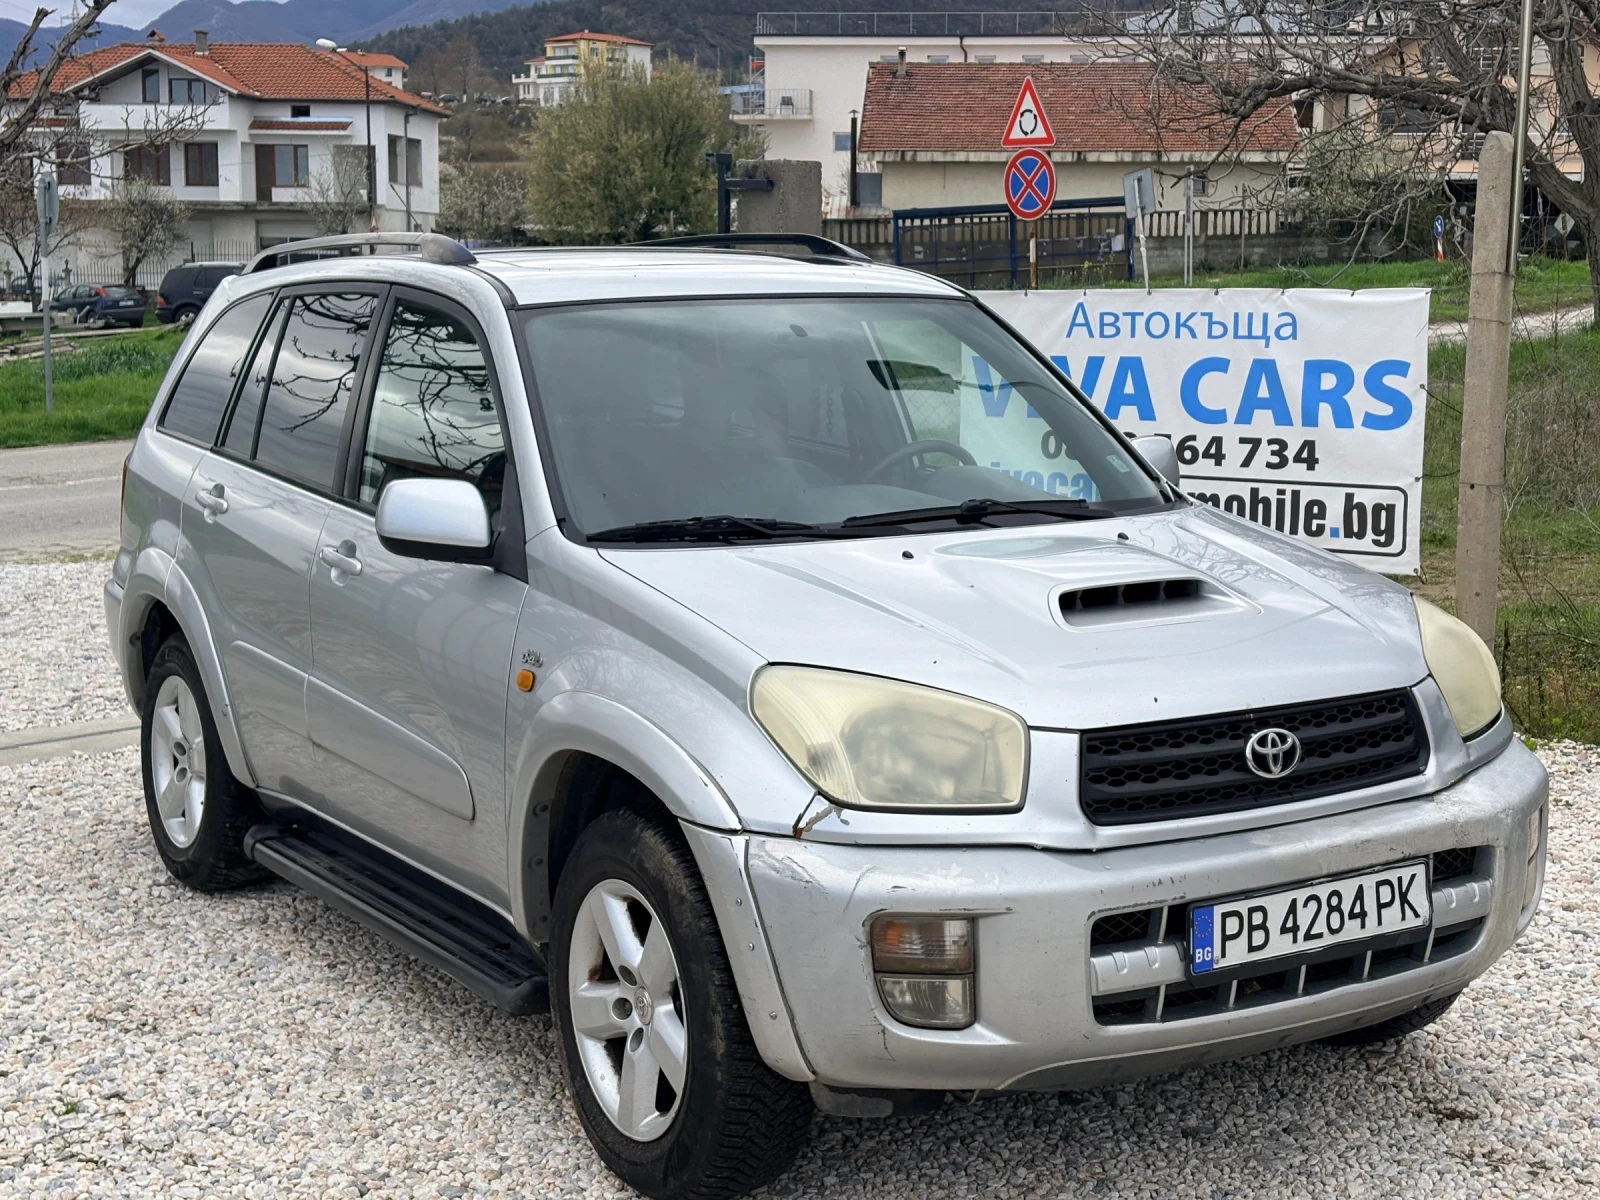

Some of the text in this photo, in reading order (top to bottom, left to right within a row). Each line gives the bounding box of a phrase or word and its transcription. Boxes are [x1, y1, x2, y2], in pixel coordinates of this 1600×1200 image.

[1066, 301, 1298, 348] Автокъща
[1179, 356, 1413, 431] CARS
[1154, 433, 1226, 467] 64
[1238, 436, 1319, 471] 734
[1221, 873, 1421, 959] PB 4284 PK
[1195, 946, 1212, 963] BG
